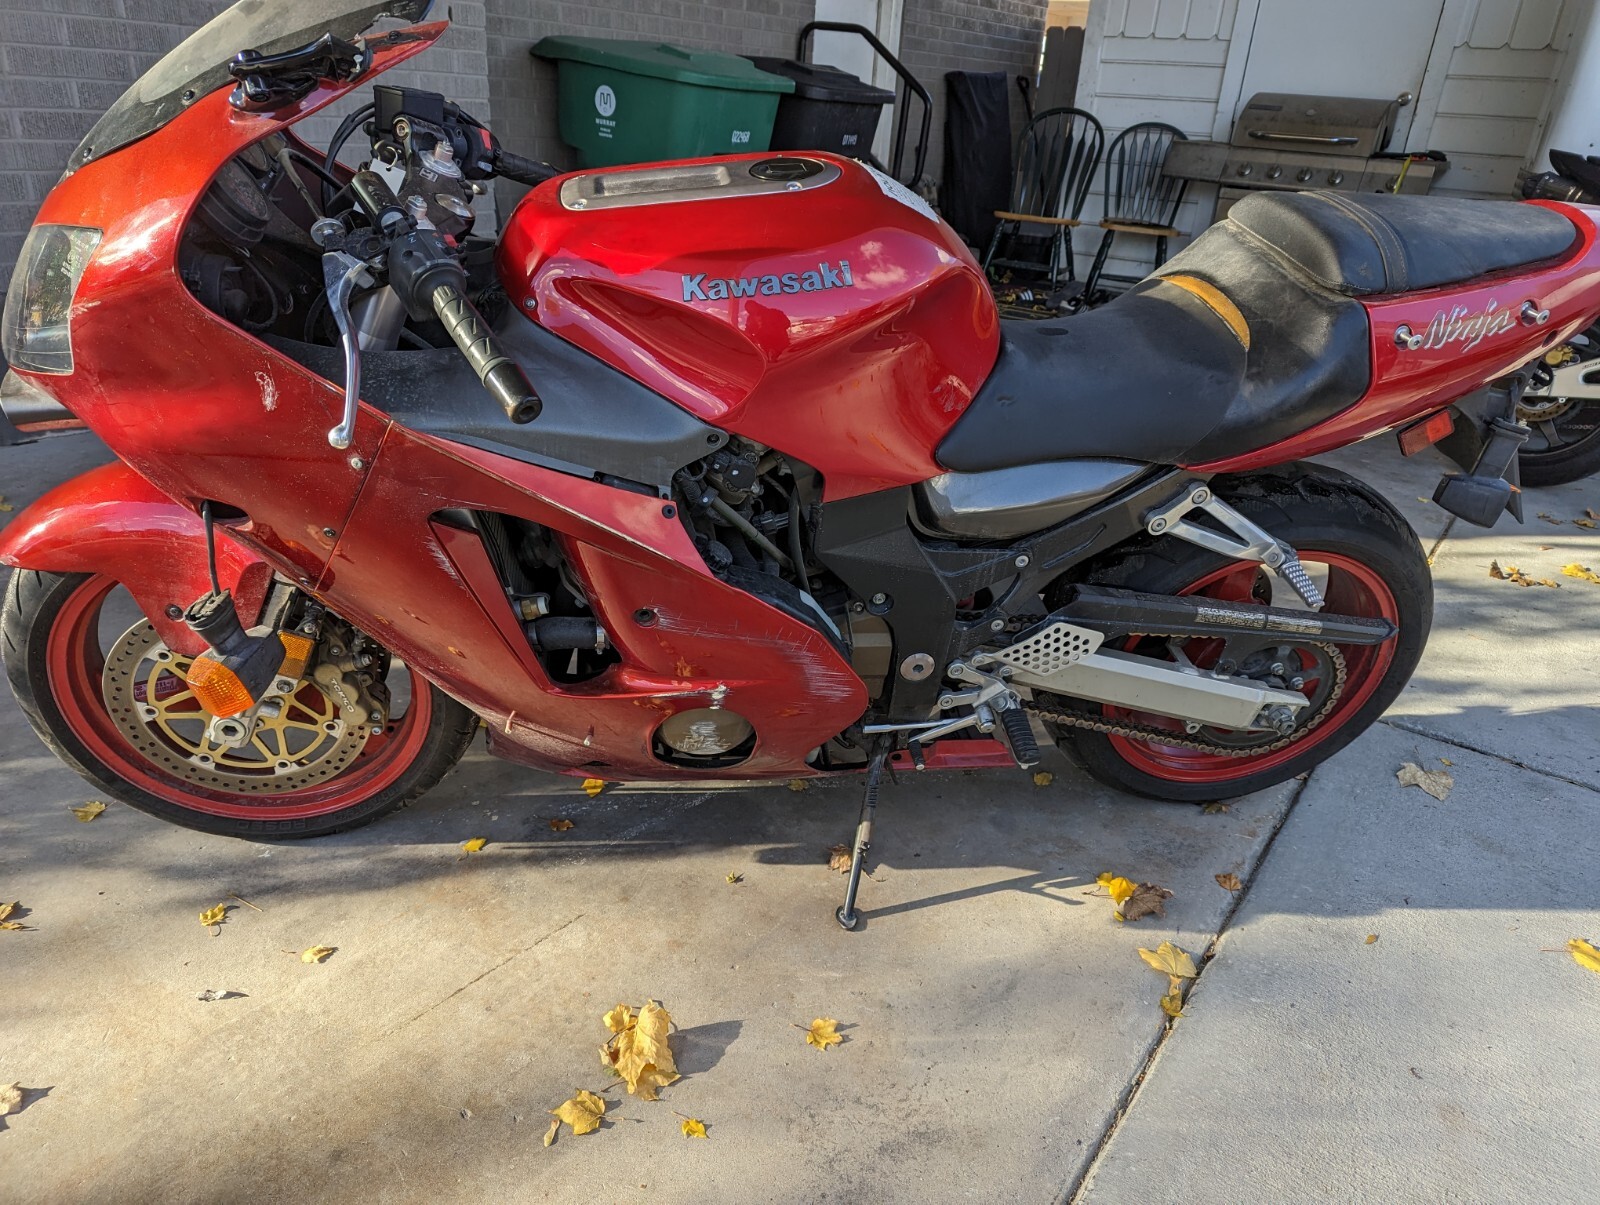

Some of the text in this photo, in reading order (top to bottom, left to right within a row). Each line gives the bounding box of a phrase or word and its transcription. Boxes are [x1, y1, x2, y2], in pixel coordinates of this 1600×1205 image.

[681, 260, 854, 302] Kawasaki
[1423, 298, 1516, 353] Ninja
[331, 678, 354, 712] TOKICO
